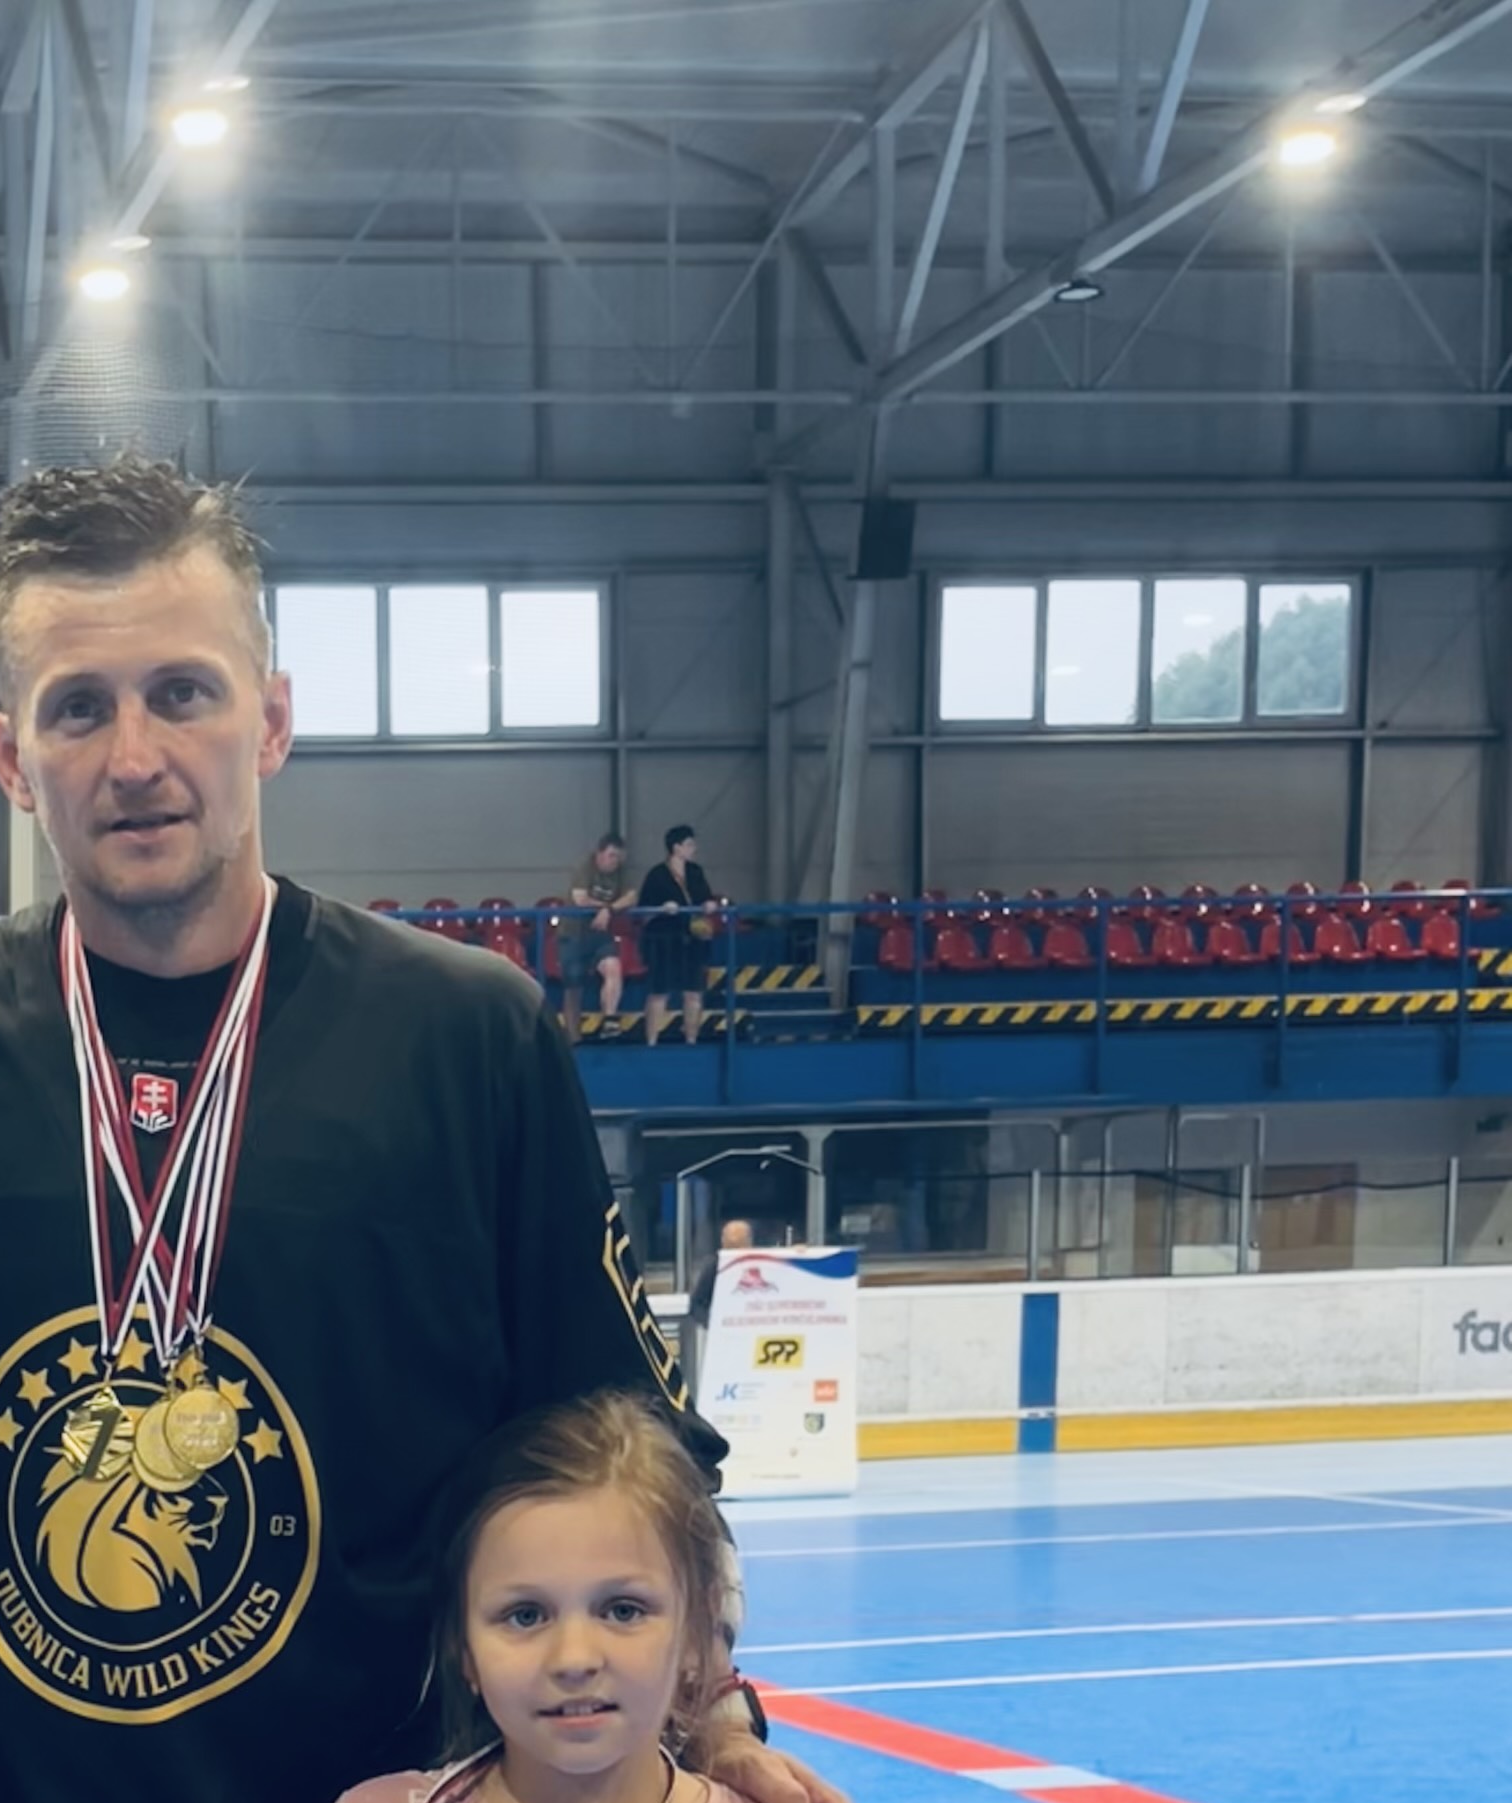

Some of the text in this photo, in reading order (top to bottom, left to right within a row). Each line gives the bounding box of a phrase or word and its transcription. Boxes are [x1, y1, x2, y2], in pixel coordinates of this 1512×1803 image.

[757, 1339, 800, 1365] SPP
[269, 1514, 296, 1537] 03
[100, 1652, 190, 1699] WILD
[188, 1580, 282, 1676] KINGS
